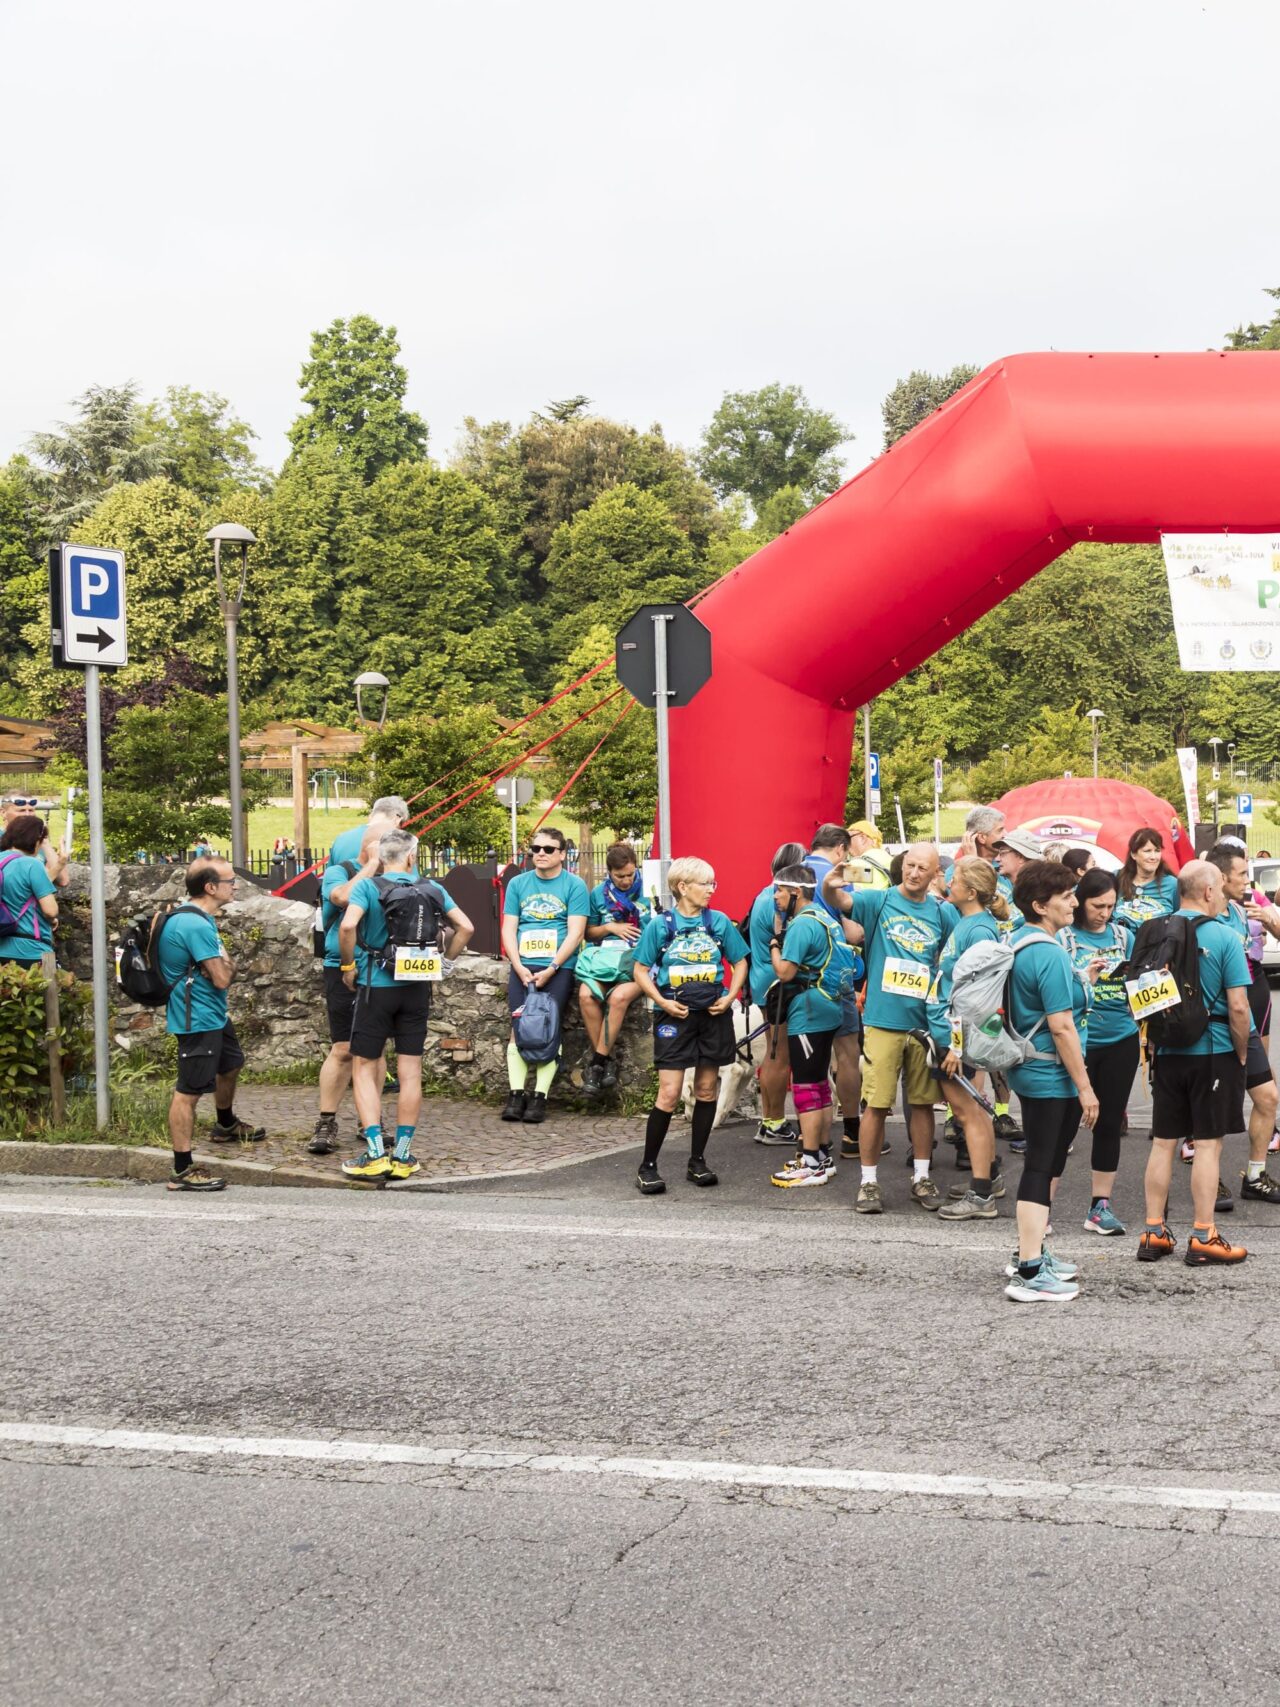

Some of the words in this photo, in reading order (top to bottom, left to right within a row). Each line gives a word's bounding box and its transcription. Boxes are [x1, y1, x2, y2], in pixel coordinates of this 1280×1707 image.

[80, 563, 109, 611] P
[869, 756, 877, 786] P
[1239, 795, 1250, 813] P
[1040, 827, 1082, 836] IRIDE
[416, 904, 424, 940] SALOMON
[526, 939, 551, 950] 1506
[404, 959, 435, 971] 0468
[892, 971, 922, 988] 1754
[1135, 983, 1169, 1005] 1034
